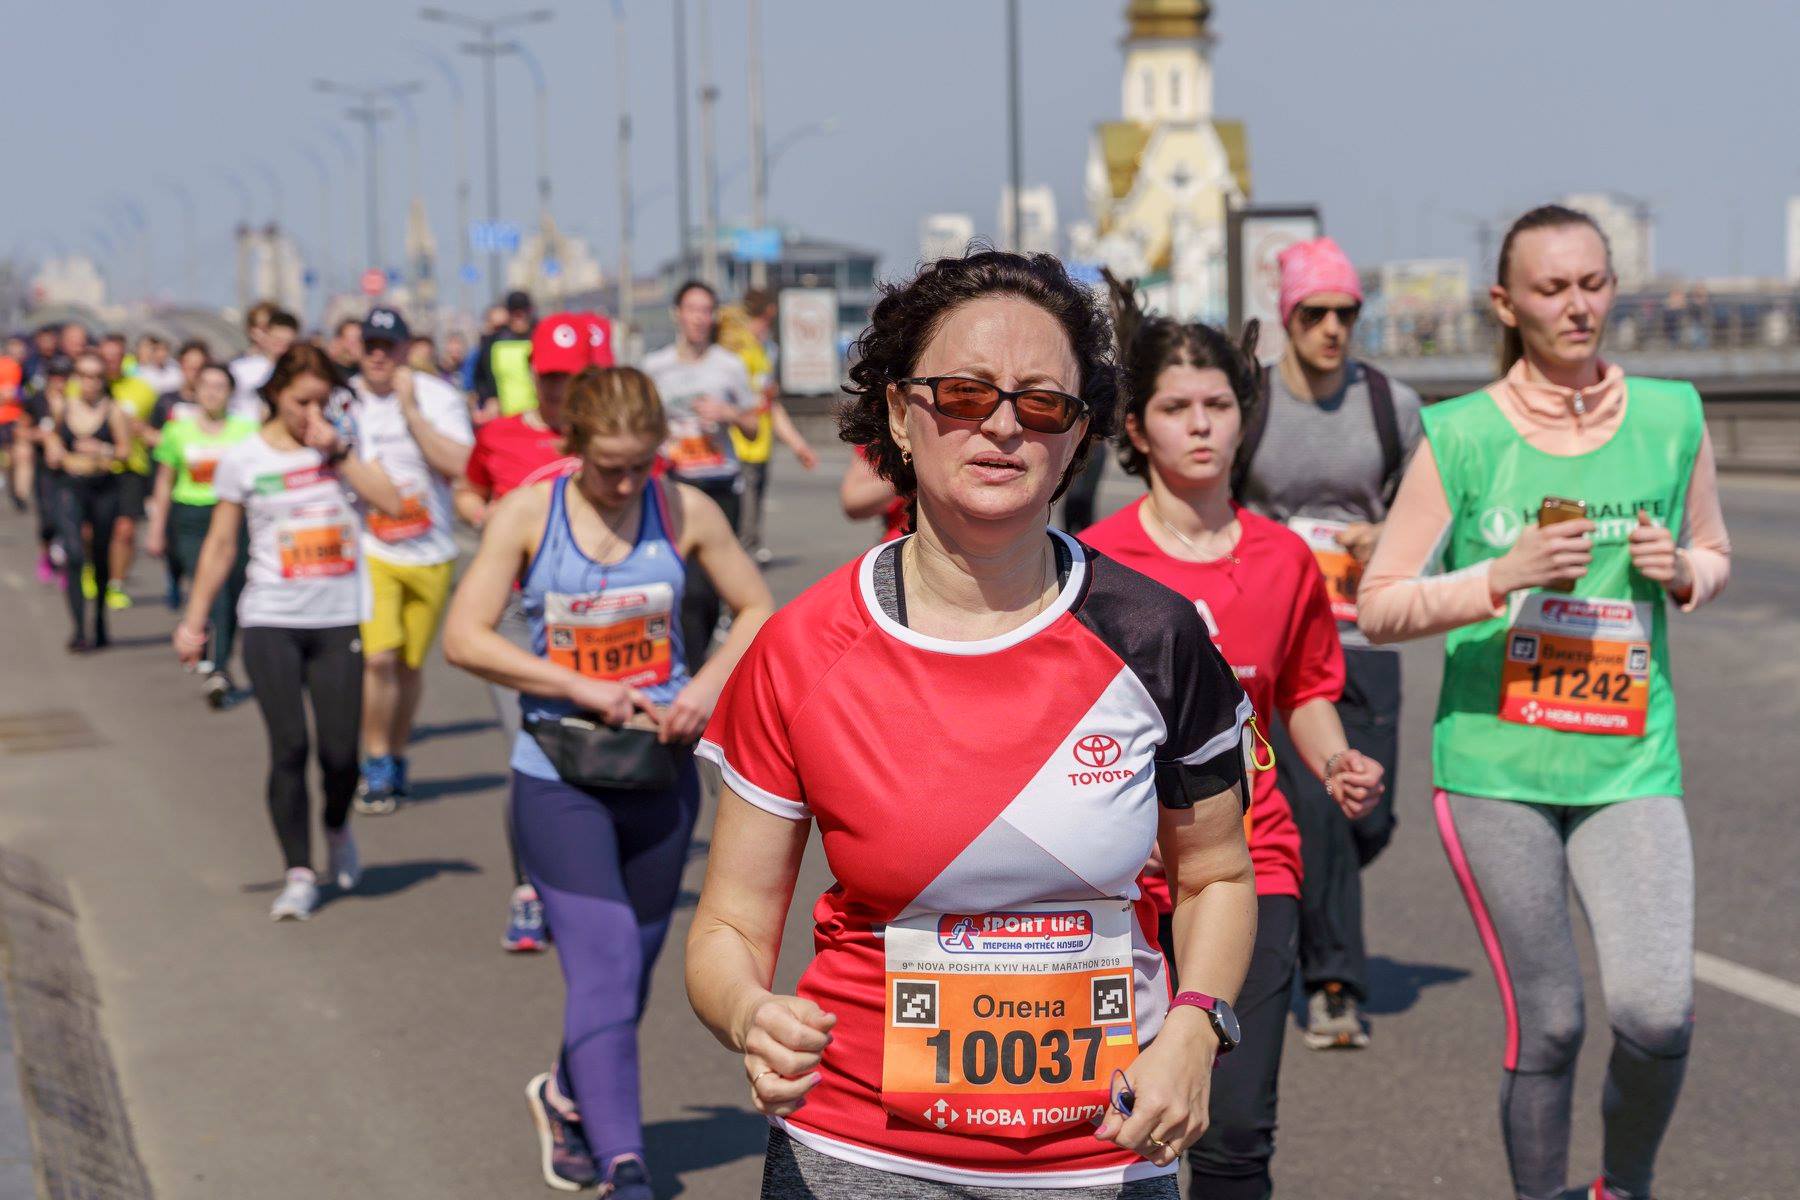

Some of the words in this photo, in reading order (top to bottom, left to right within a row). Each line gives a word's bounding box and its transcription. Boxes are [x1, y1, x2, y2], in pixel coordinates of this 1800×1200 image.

[571, 639, 653, 672] 11970
[1528, 664, 1632, 702] 11242
[1068, 770, 1135, 786] TOYOTA
[982, 916, 1045, 933] SPORT
[1051, 915, 1086, 932] LIFE
[982, 942, 1022, 950] МЕРЕЖА
[1024, 941, 1055, 950] ФІТНЕС
[917, 962, 945, 971] NOVA
[948, 963, 990, 972] POSHTA
[994, 963, 1019, 972] KYIV
[1022, 963, 1050, 972] HALF
[1052, 960, 1099, 972] MARATHON
[1101, 957, 1120, 967] 2019
[973, 994, 1066, 1018] Олена
[926, 1026, 1103, 1086] 10037
[966, 1108, 1026, 1126] НОВА
